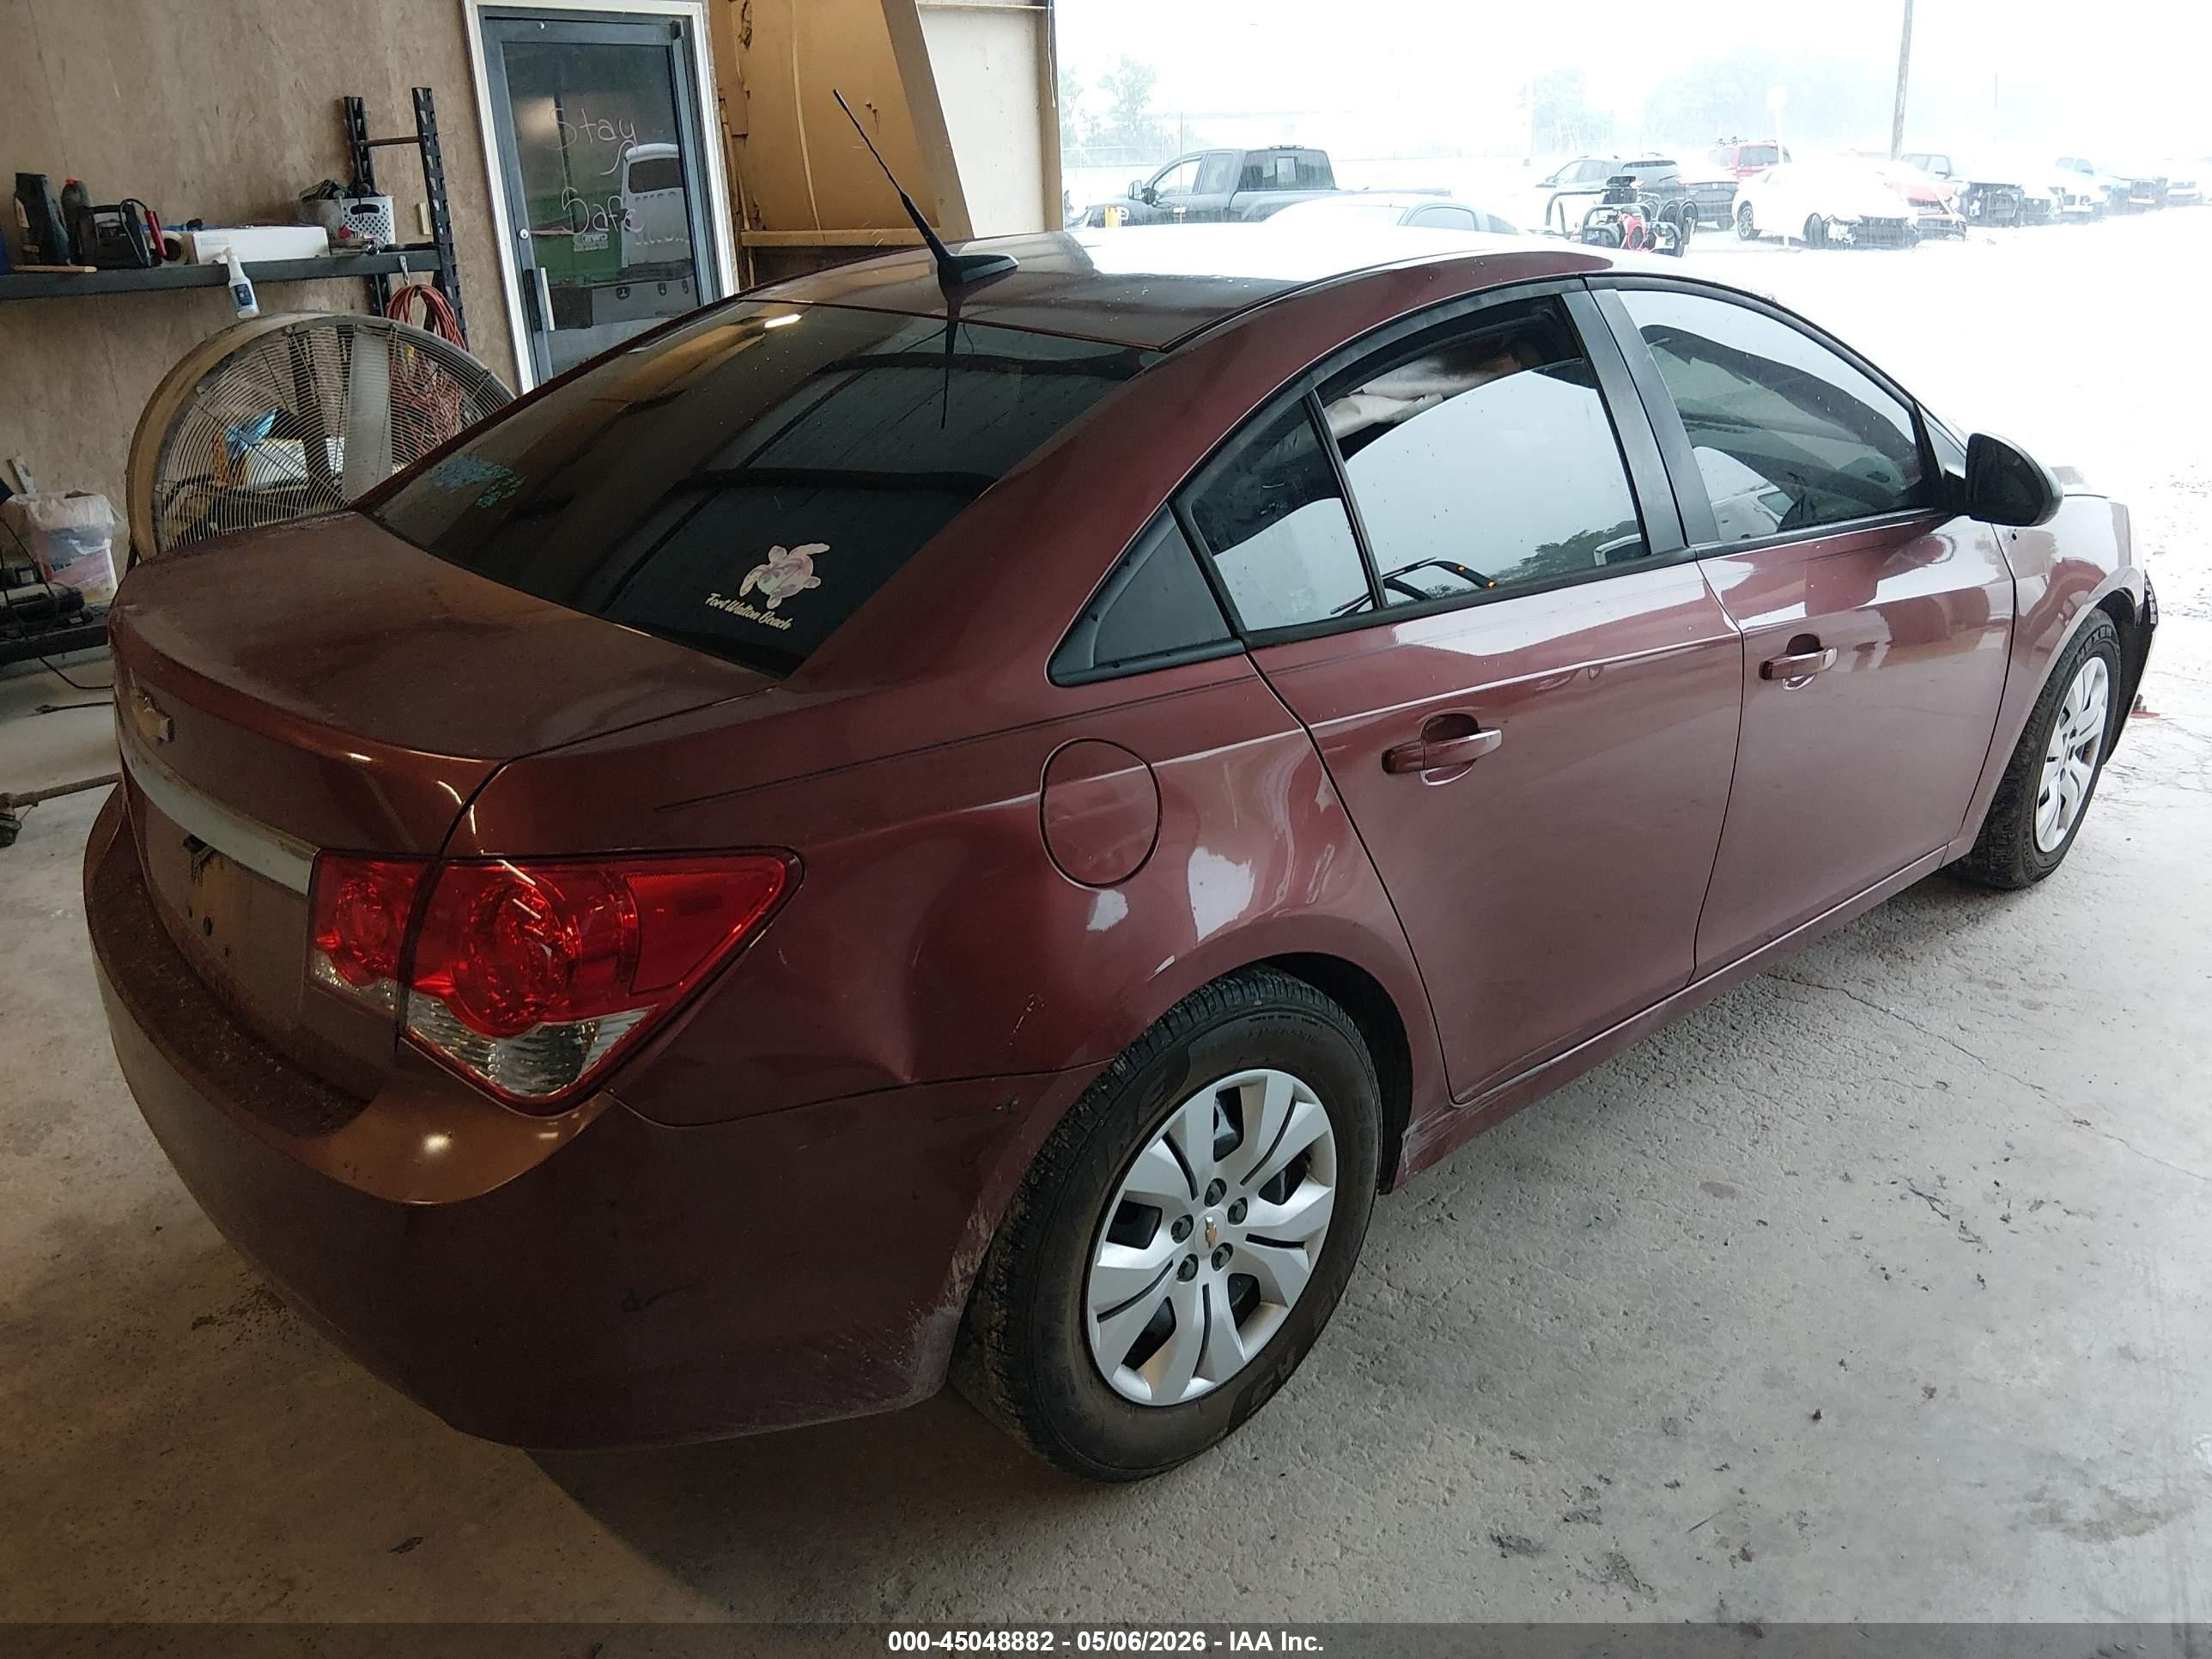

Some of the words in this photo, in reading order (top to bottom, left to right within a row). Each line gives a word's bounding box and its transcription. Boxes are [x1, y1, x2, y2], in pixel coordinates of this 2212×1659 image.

[550, 107, 639, 175] Stay
[561, 185, 645, 235] Safe
[725, 599, 762, 620] Walton
[757, 611, 793, 630] Beach
